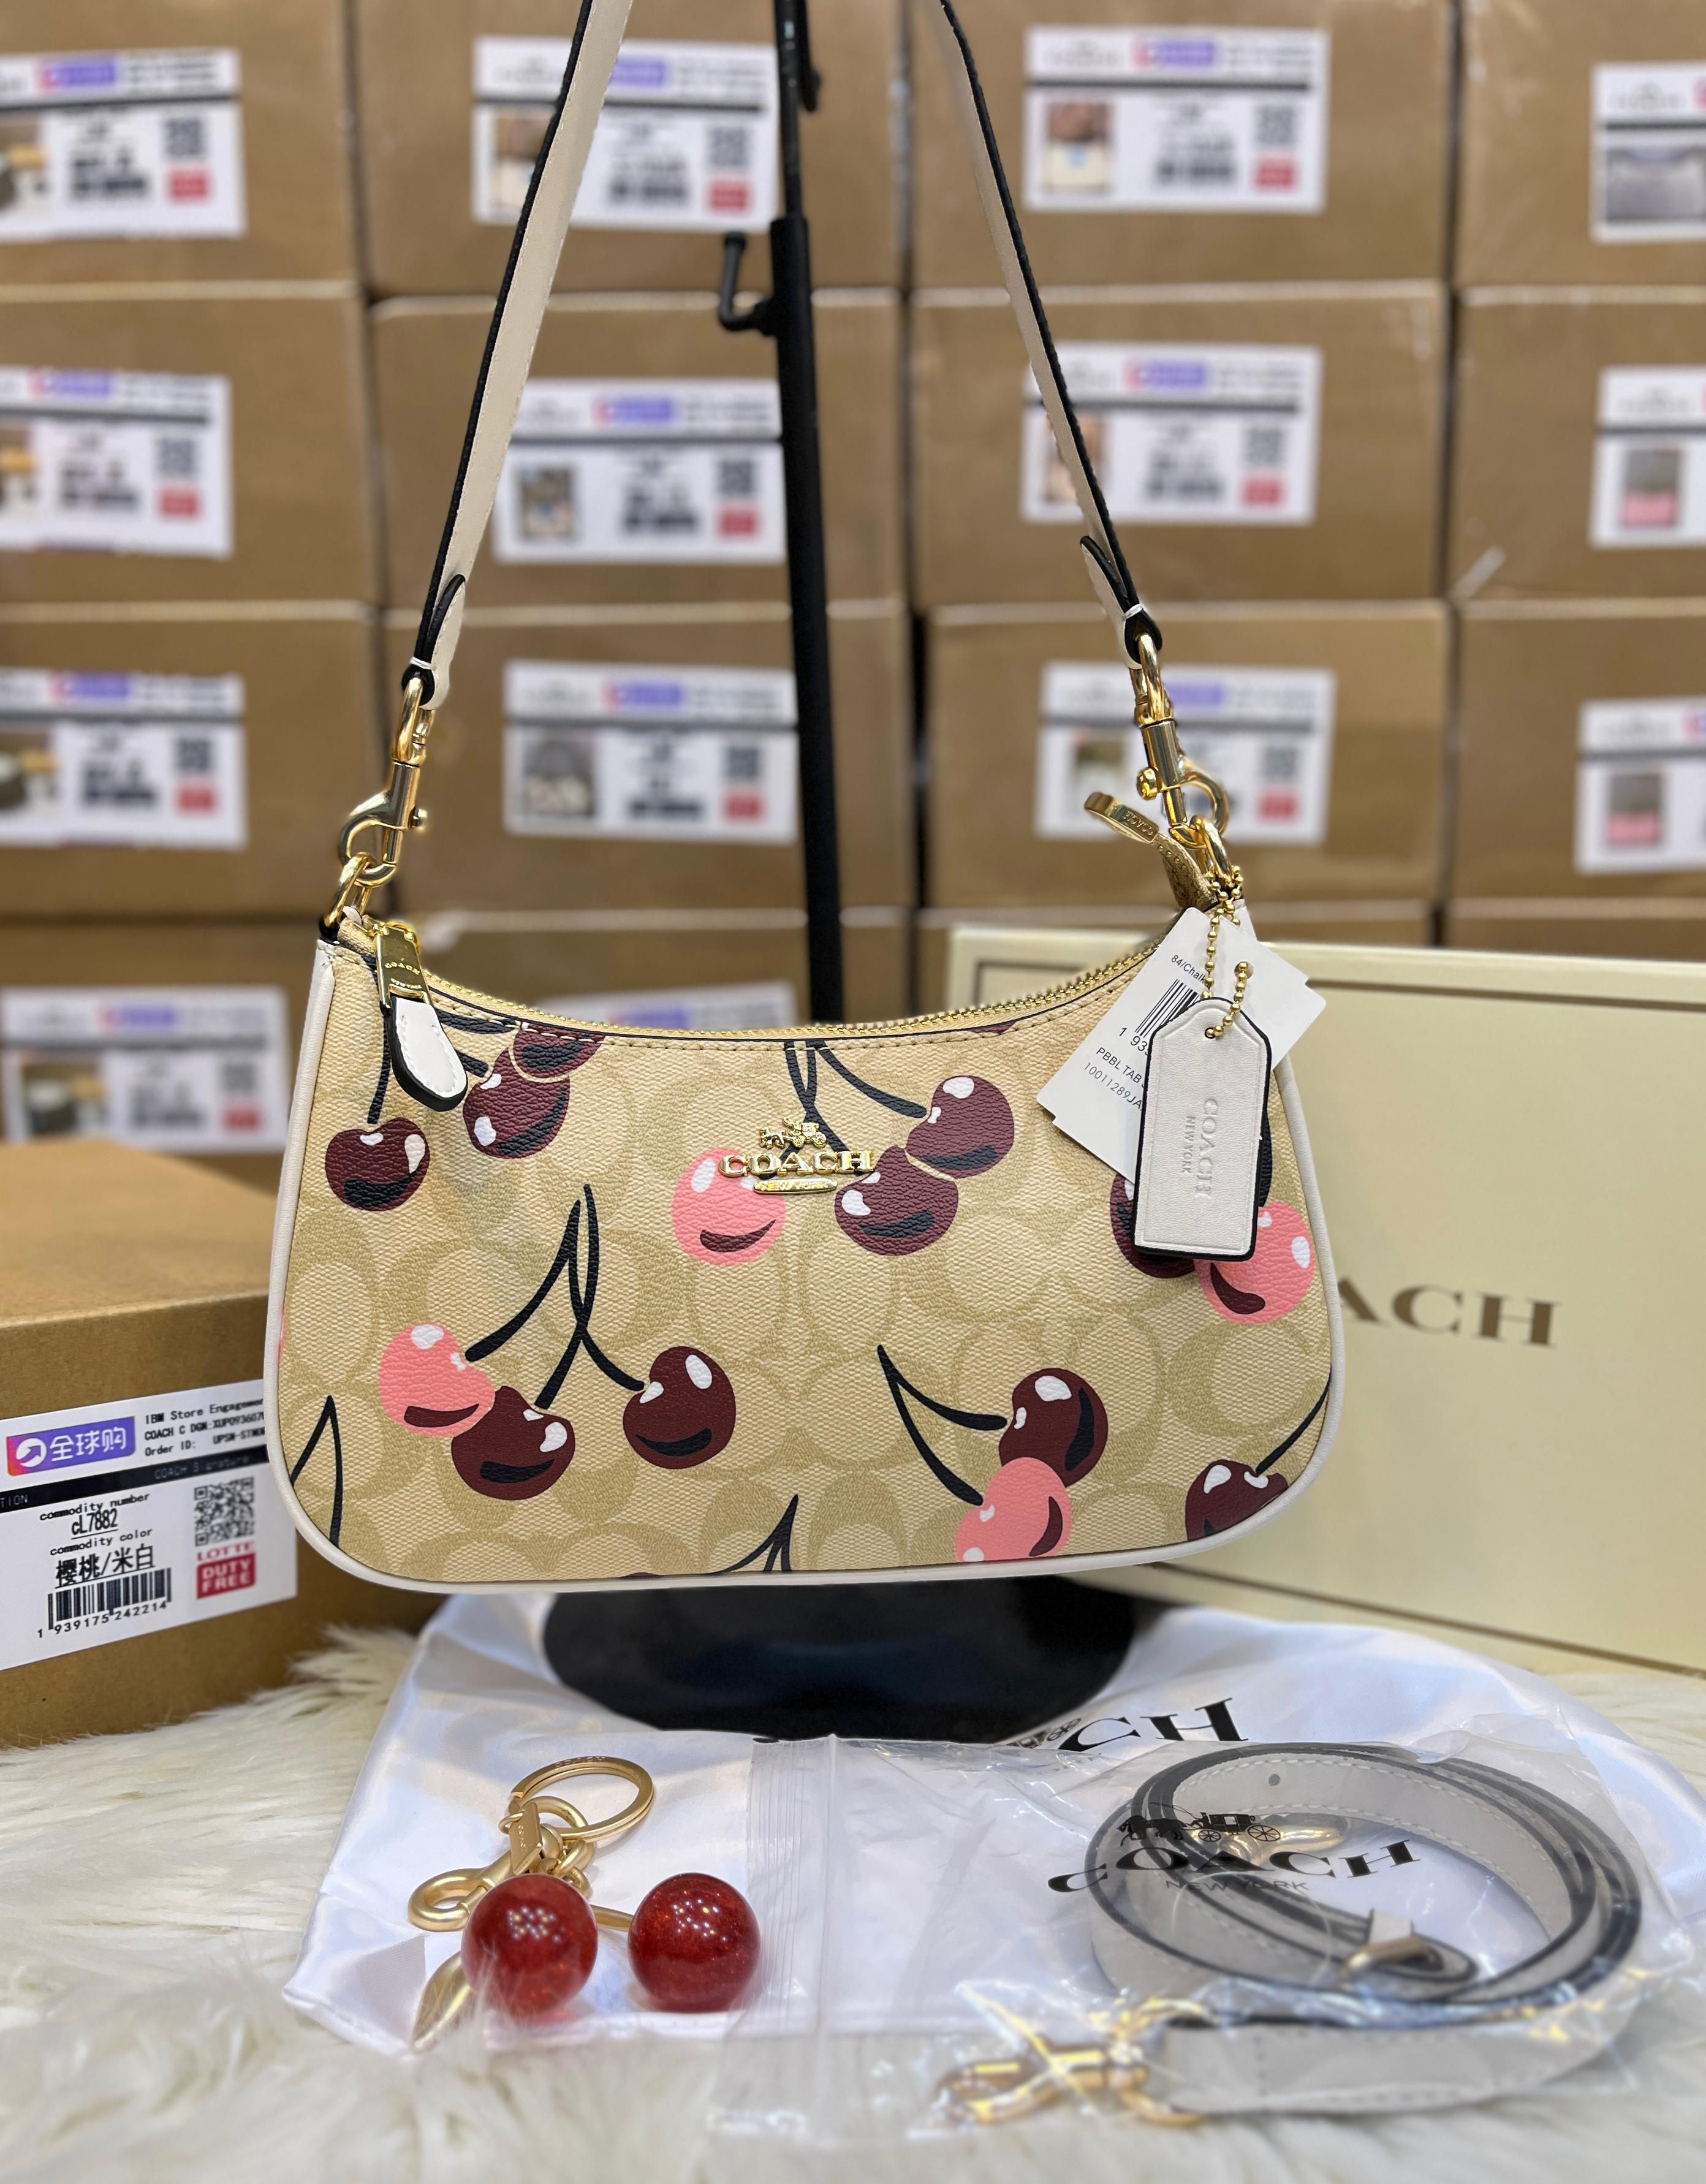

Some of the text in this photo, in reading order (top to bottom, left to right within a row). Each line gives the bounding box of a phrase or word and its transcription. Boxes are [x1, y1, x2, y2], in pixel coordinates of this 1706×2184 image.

[1118, 1027, 1128, 1037] 1
[1096, 1047, 1142, 1083] PBBL TAB
[1083, 1062, 1143, 1111] 10011289JA
[1181, 1115, 1196, 1174] NEW YORK
[1196, 1098, 1218, 1197] COACH
[718, 1150, 875, 1178] COACH
[170, 1409, 203, 1420] Store
[50, 1425, 127, 1462] 全球购
[145, 1427, 174, 1441] COACH
[145, 1445, 173, 1457] Order
[181, 1440, 195, 1450] ID:
[154, 1466, 187, 1479] COACH
[40, 1493, 150, 1521] commodity number
[50, 1528, 153, 1556] commodity color
[56, 1543, 154, 1588] 樱桃/米白
[202, 1557, 252, 1580] DUTY
[202, 1571, 252, 1593] FREE
[1048, 1839, 1420, 1892] COACH
[1166, 1879, 1310, 1892] NEW YORK
